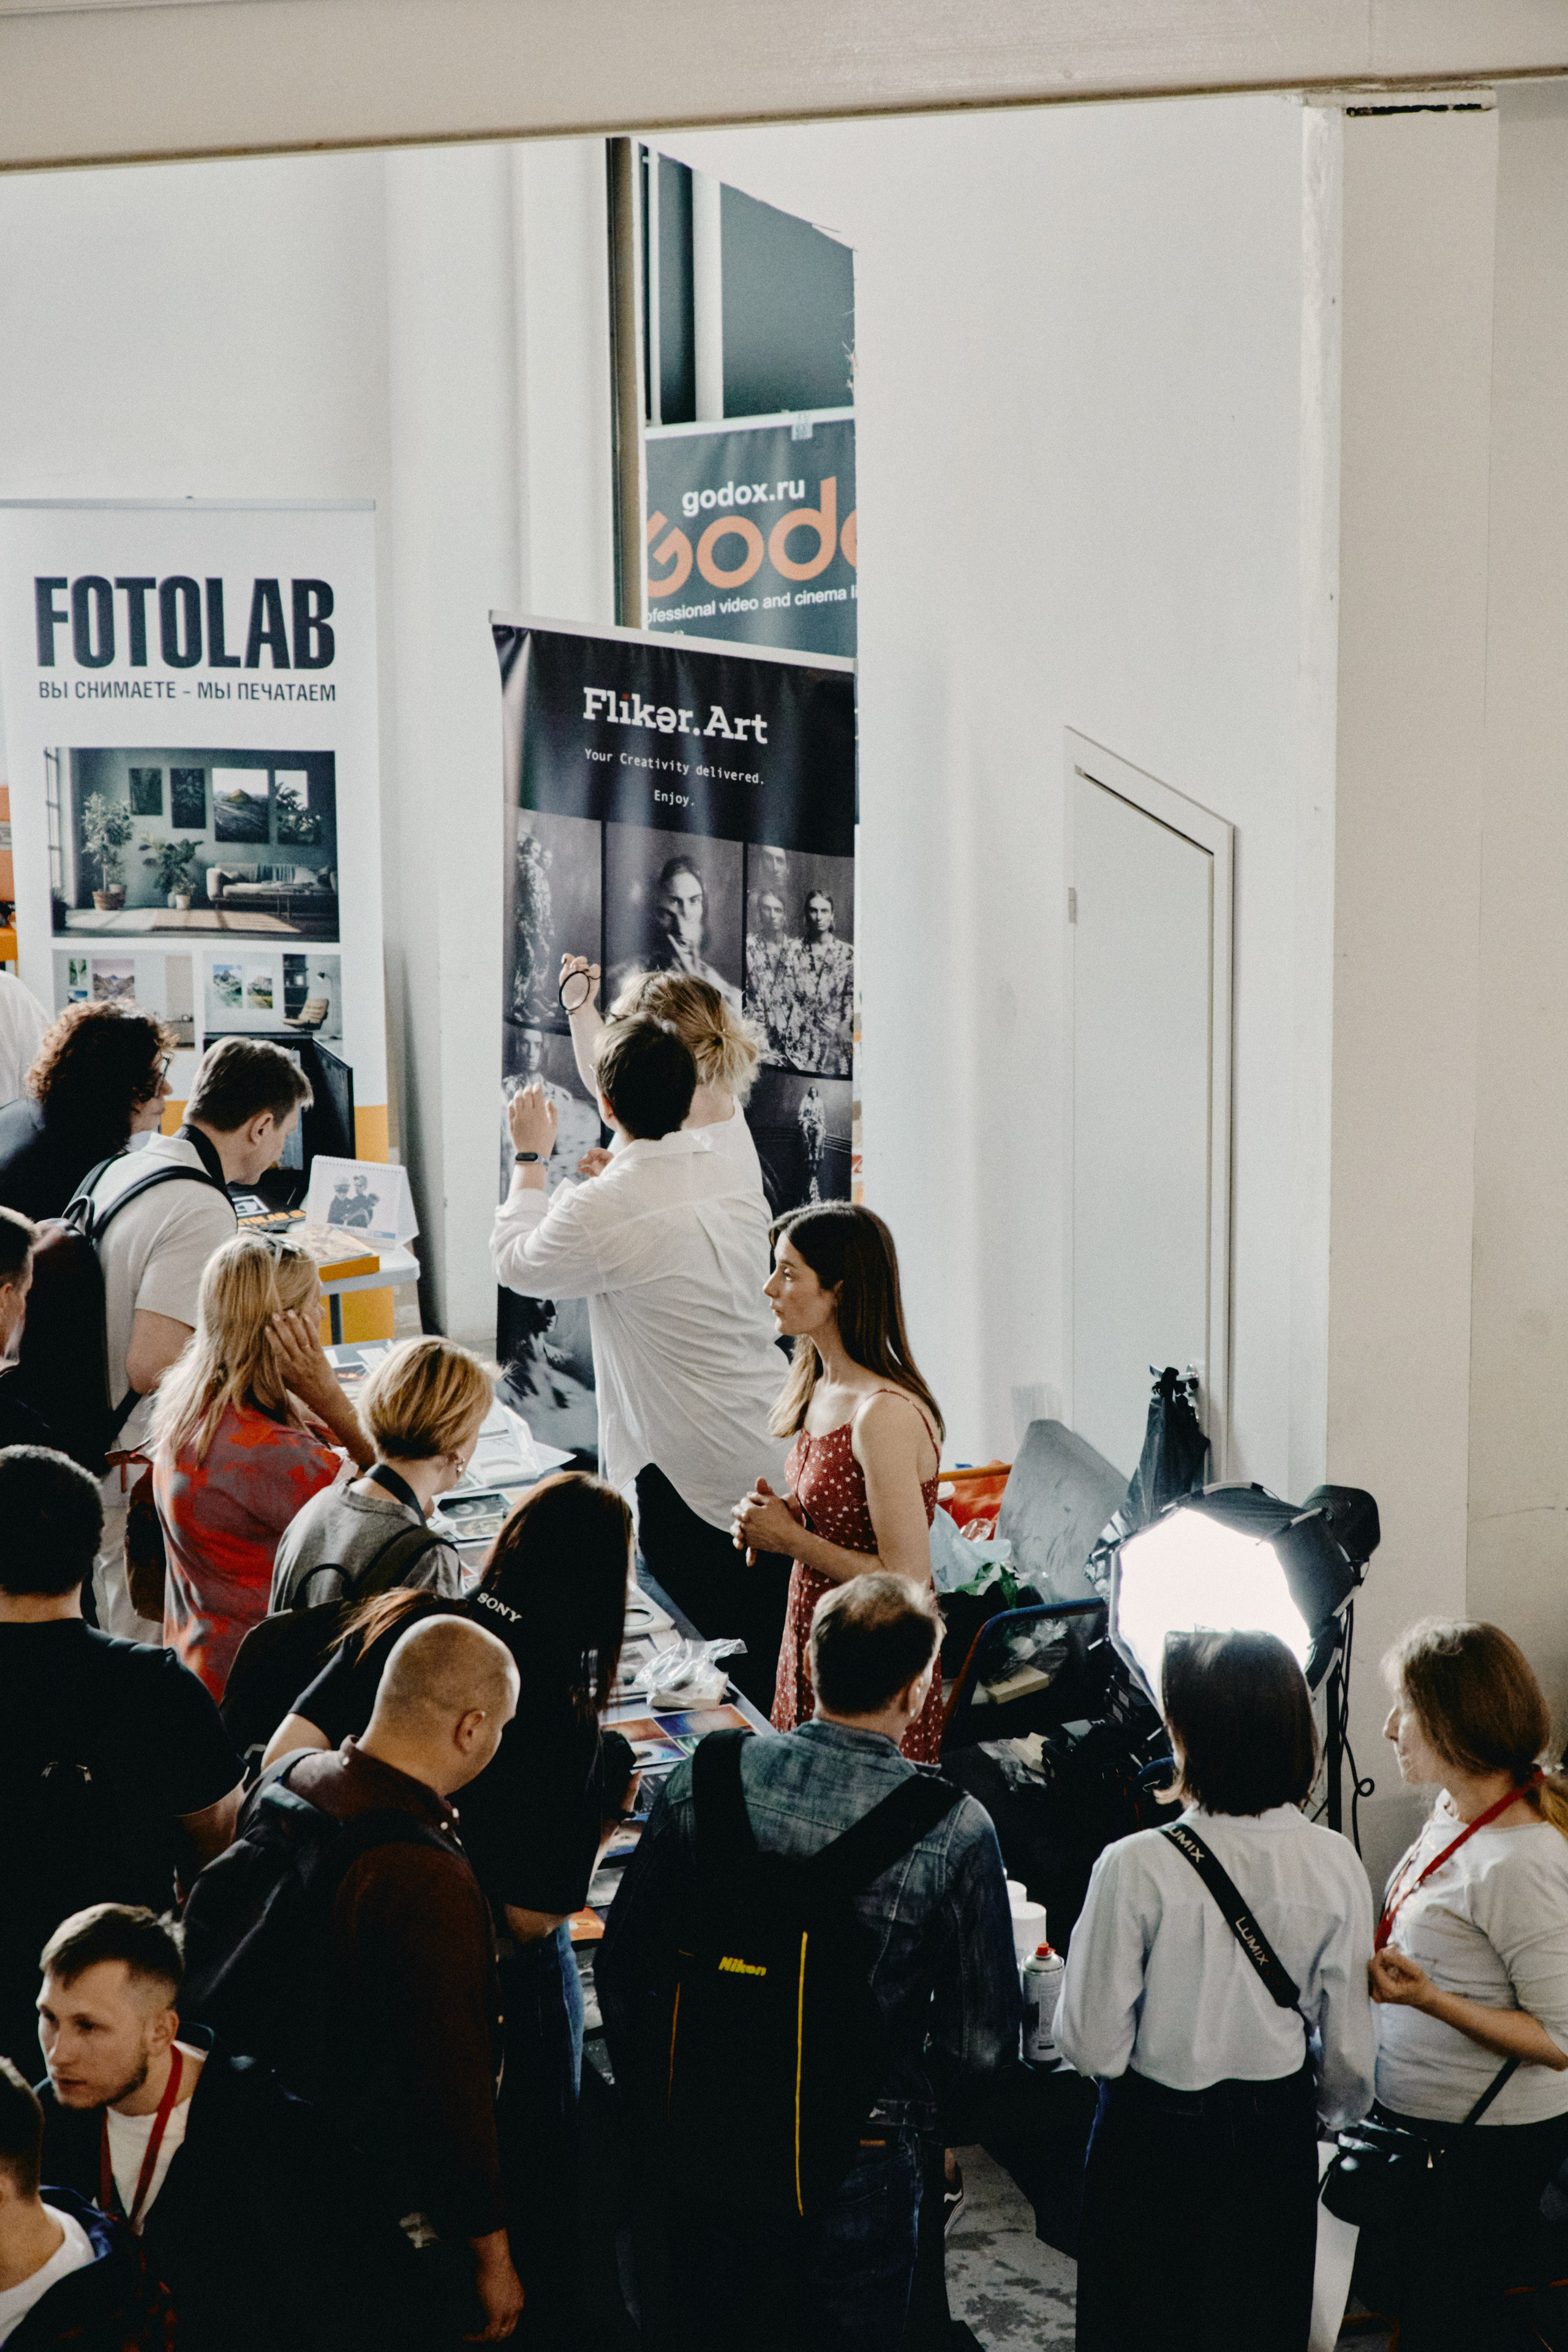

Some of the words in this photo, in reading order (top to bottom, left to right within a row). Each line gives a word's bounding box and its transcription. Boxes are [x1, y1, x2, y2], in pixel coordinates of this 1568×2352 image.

[682, 480, 805, 516] godox.ru
[647, 476, 856, 597] God
[719, 598, 758, 613] video
[763, 592, 791, 609] and
[794, 589, 846, 606] cinema
[34, 575, 335, 669] FOTOLAB
[39, 681, 67, 698] ВЫ
[75, 681, 176, 698] СНИМАЕТЕ
[197, 682, 230, 699] МЫ
[238, 683, 336, 701] ПЕЧАТАЕМ
[585, 748, 612, 762] Your
[620, 753, 690, 775] Creativity
[696, 764, 764, 785] delivered.
[654, 790, 695, 807] Enjoy.
[477, 1593, 522, 1623] SONY
[1235, 1916, 1270, 1966] LUMIX
[718, 1956, 767, 1977] Nikon
